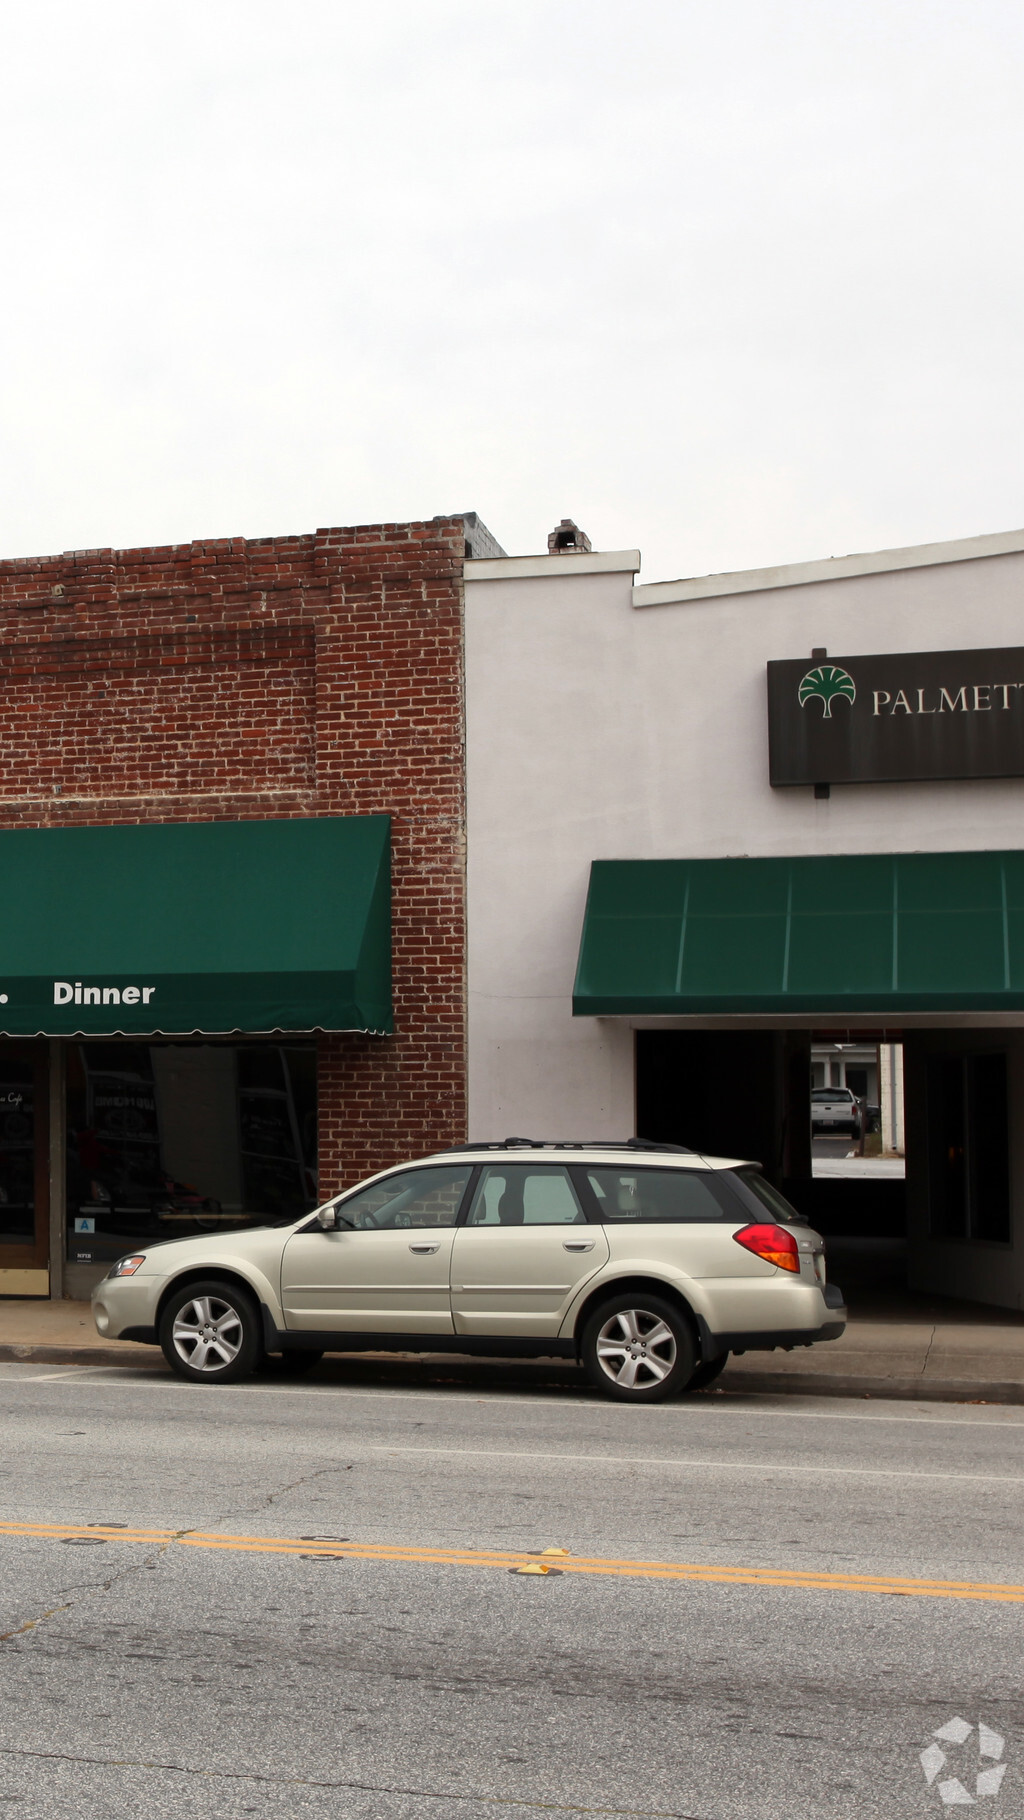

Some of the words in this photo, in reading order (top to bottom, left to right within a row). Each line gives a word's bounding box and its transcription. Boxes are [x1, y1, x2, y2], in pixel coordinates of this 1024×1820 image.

[872, 683, 1024, 716] PALMET
[53, 982, 156, 1006] Dinner
[80, 1219, 89, 1230] A
